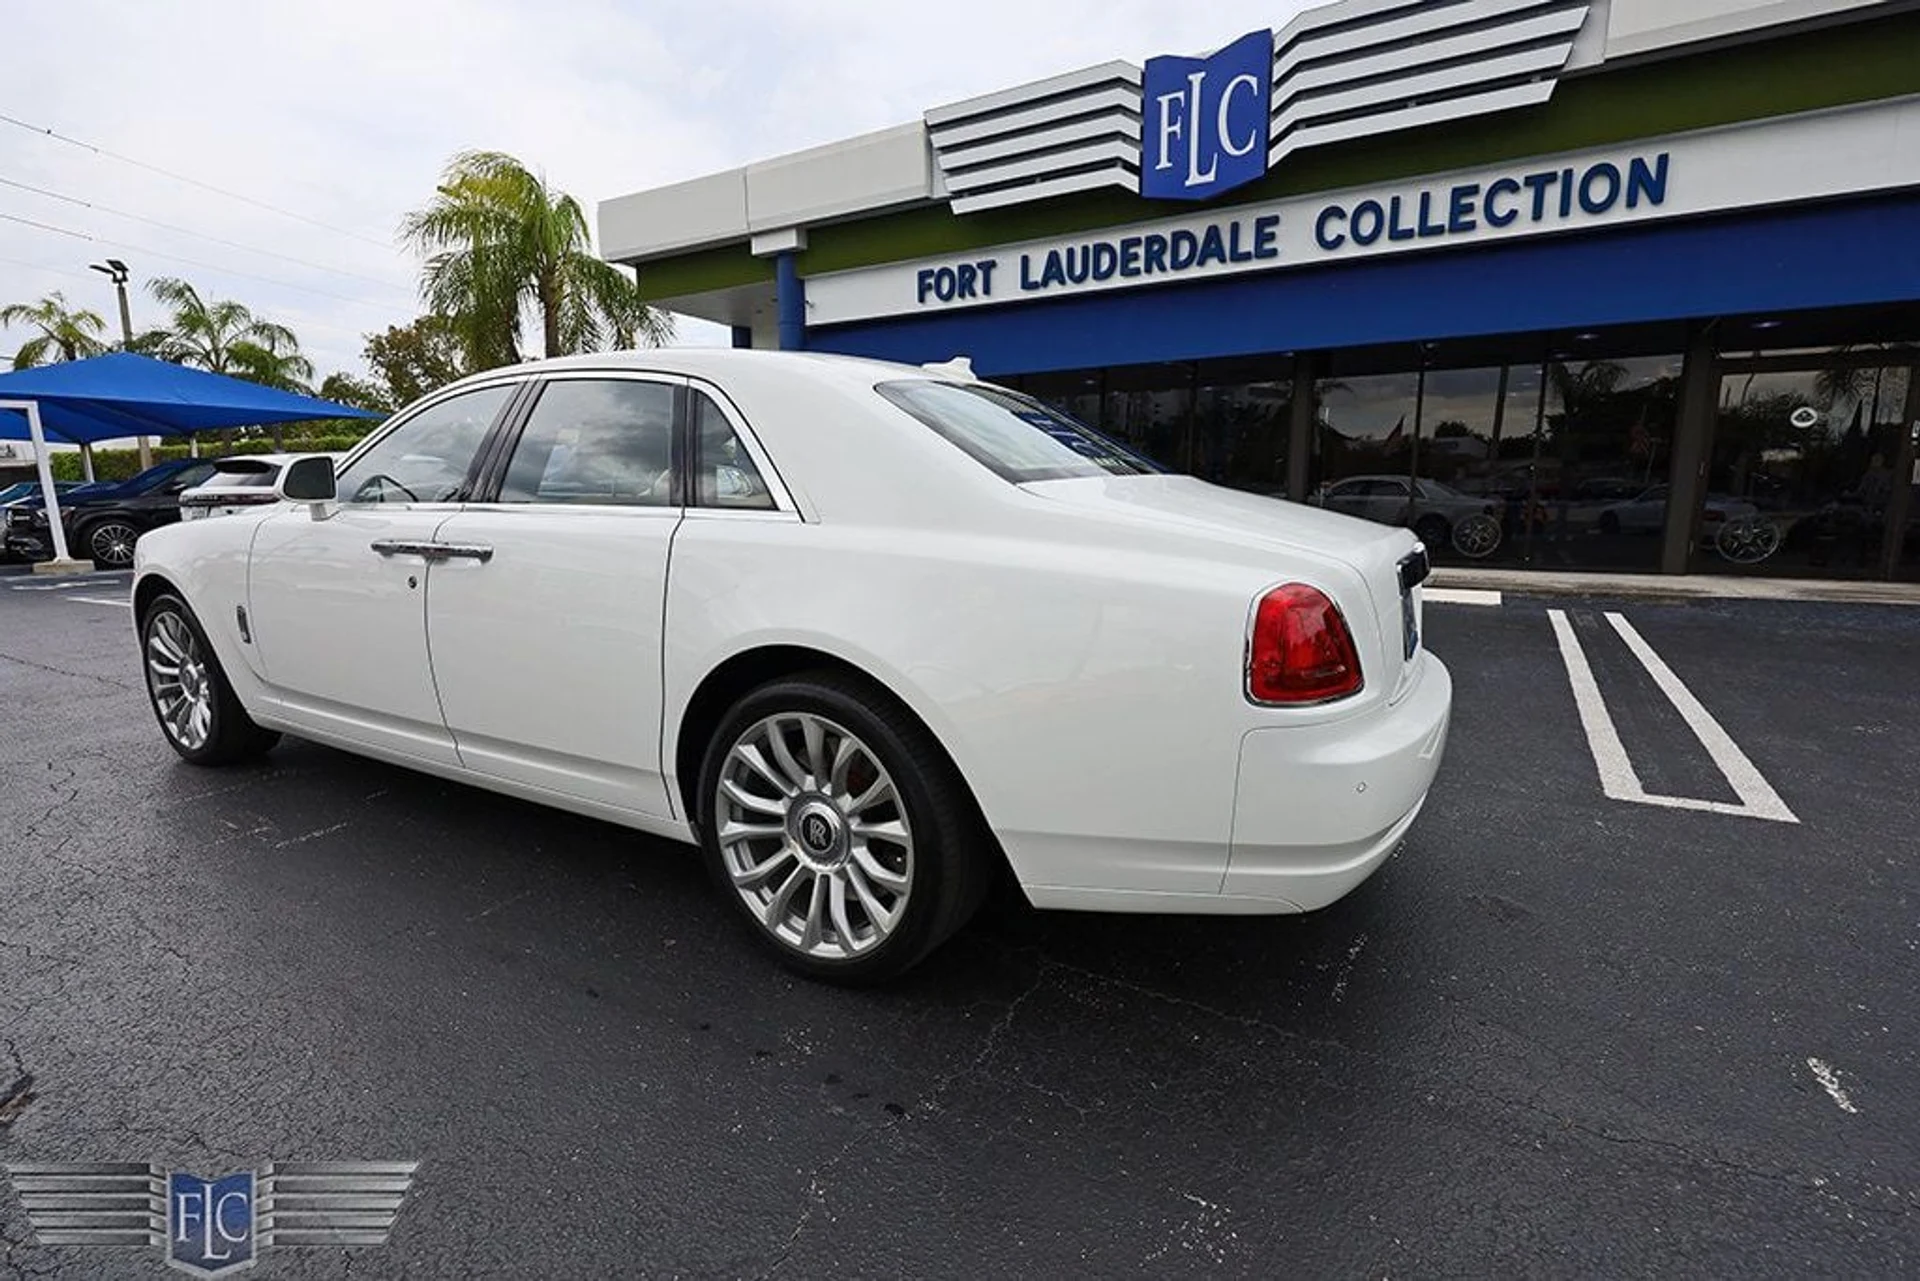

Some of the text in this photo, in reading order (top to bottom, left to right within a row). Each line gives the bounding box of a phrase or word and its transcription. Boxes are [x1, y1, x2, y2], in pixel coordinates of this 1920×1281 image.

[1156, 71, 1259, 187] FLC
[917, 152, 1670, 304] FORT LAUDERDALE COLLECTION
